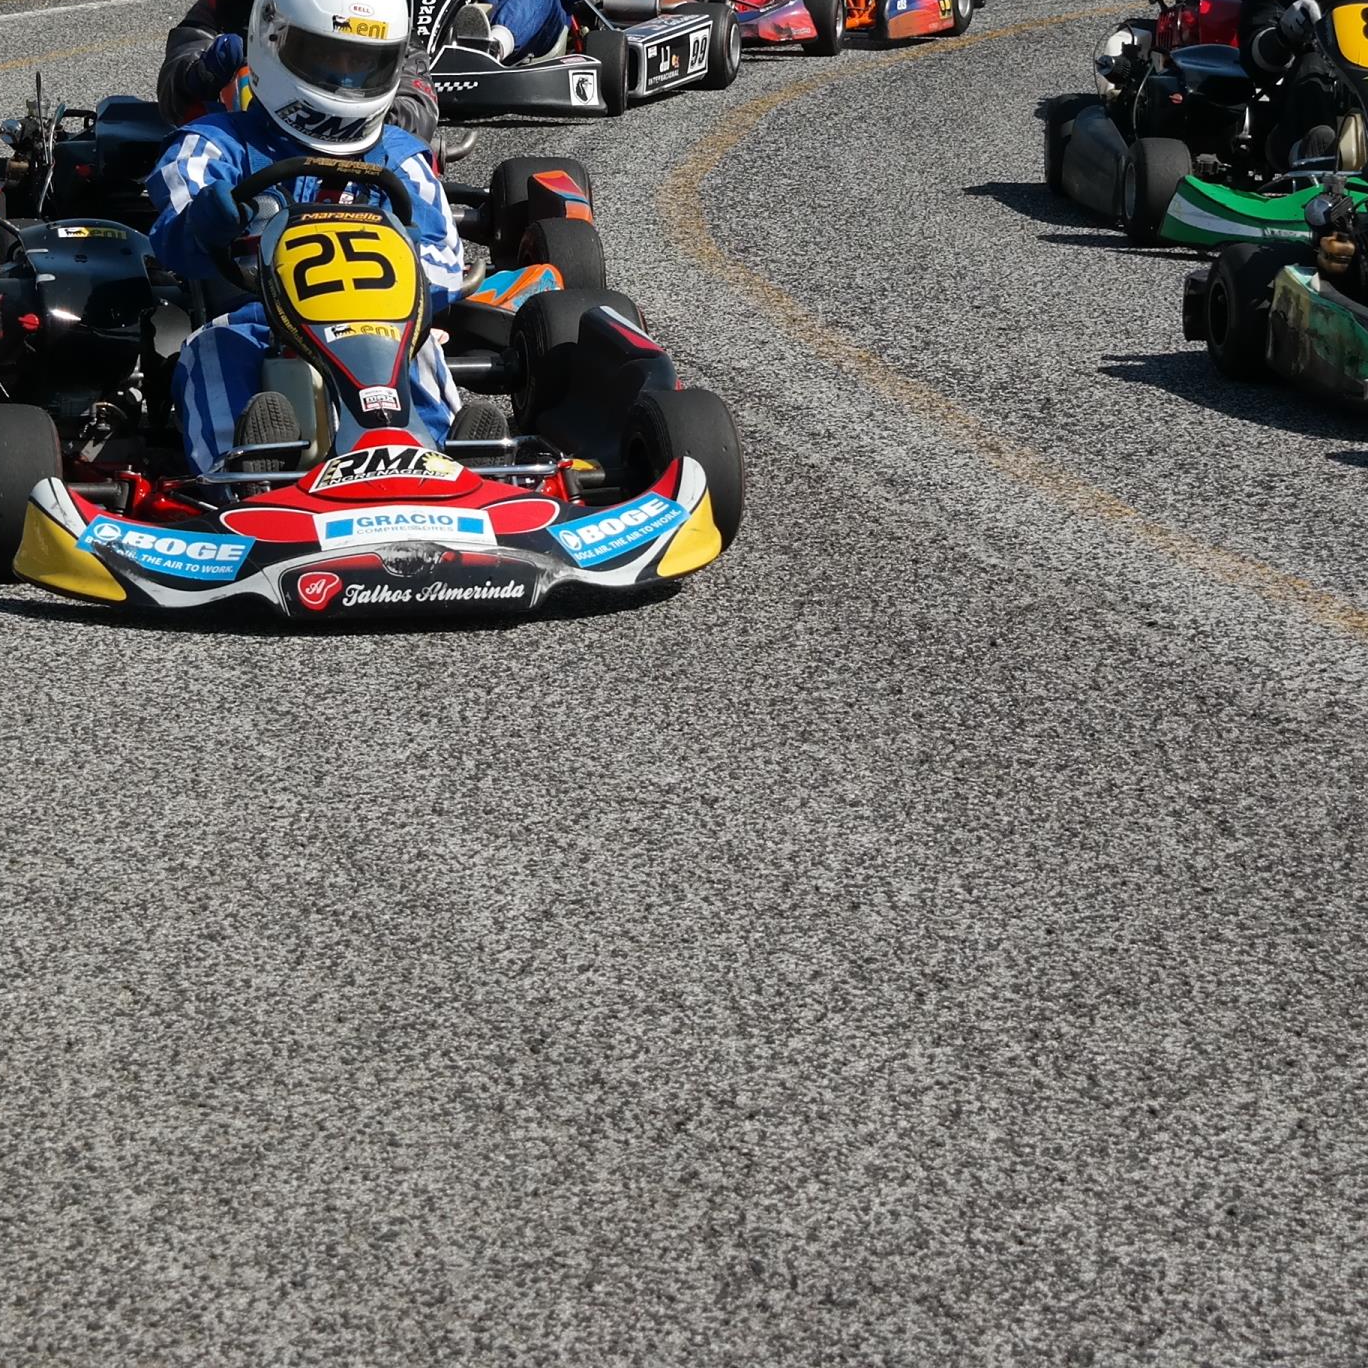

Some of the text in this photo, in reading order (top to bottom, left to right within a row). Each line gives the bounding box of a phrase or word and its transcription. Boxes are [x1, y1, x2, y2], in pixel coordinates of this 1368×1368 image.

[353, 5, 371, 14] BELL
[356, 21, 388, 40] eni
[690, 37, 708, 67] 99
[285, 232, 397, 301] 25
[360, 325, 395, 340] eni
[356, 514, 454, 527] GRACIO
[356, 524, 454, 534] COMPRESSORES
[576, 498, 670, 544] BOGE
[122, 530, 246, 561] BOGE
[611, 537, 628, 549] THE
[627, 530, 643, 543] AIR
[640, 525, 653, 536] TO
[141, 554, 163, 566] THE
[163, 559, 184, 570] AIR
[185, 563, 200, 573] TO
[342, 580, 525, 607] Talhos Almerinda
